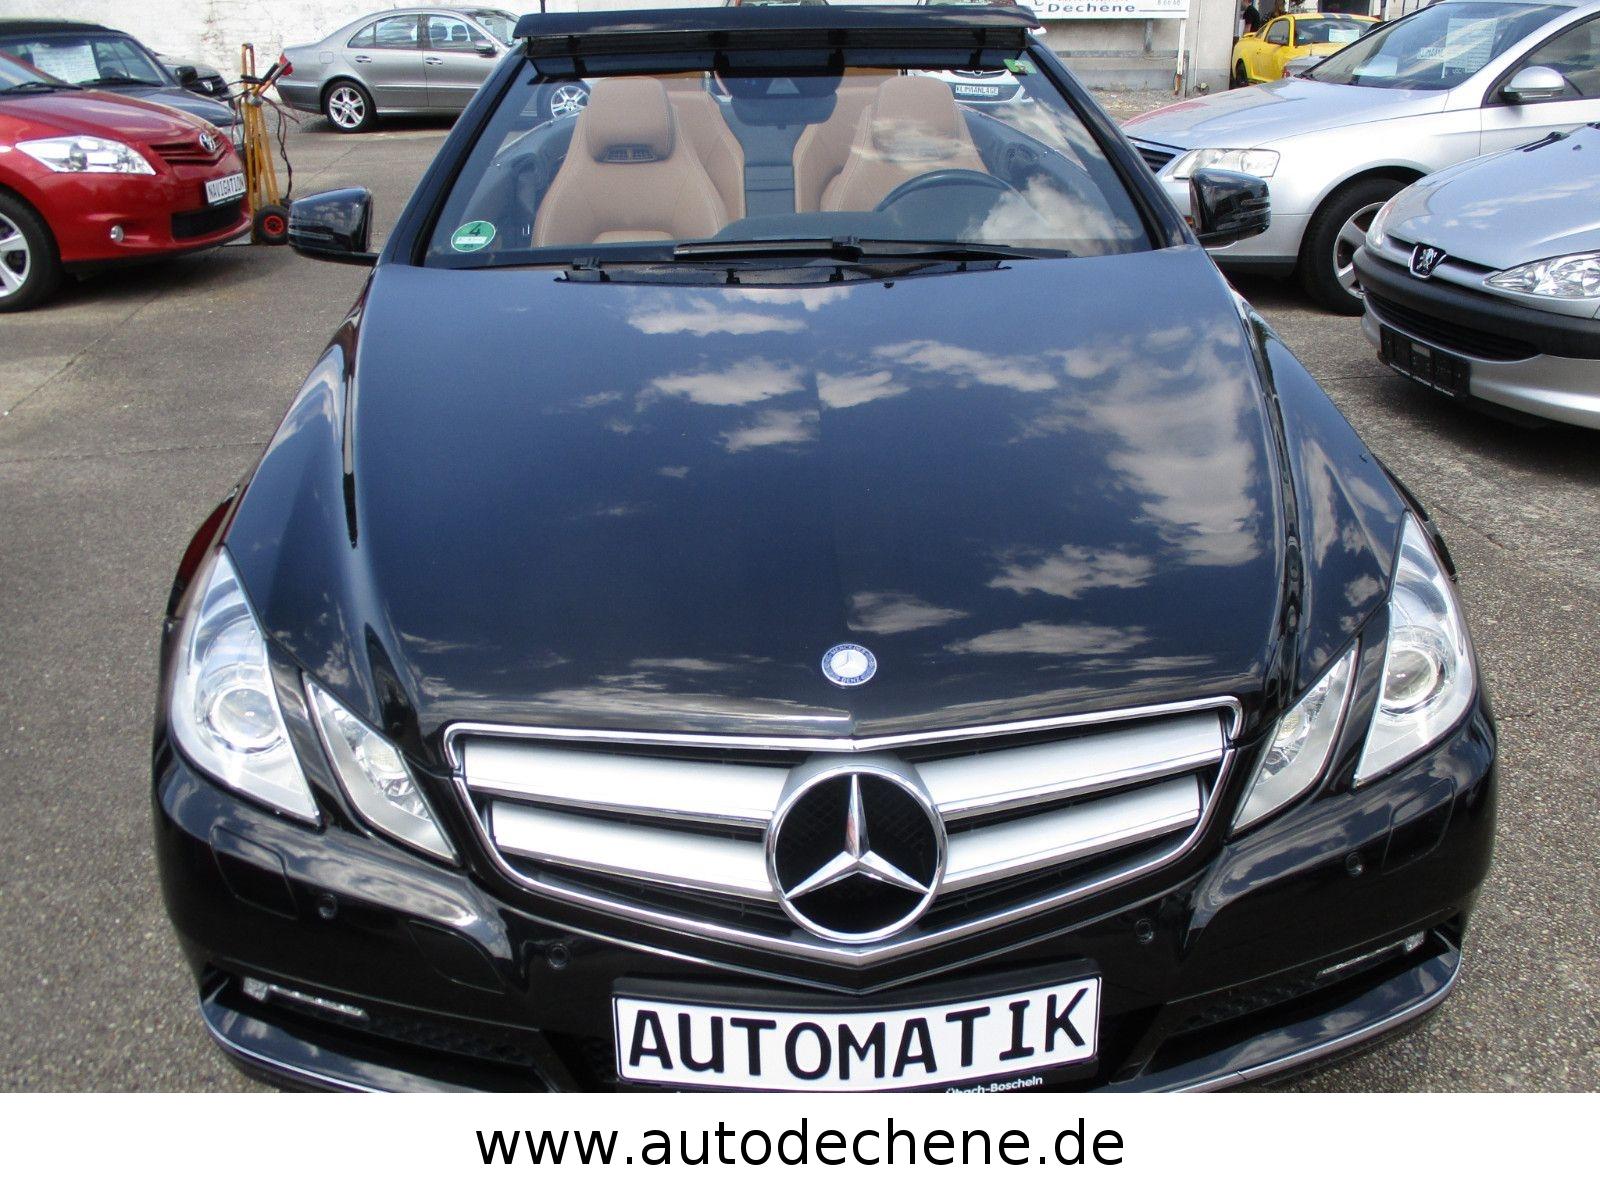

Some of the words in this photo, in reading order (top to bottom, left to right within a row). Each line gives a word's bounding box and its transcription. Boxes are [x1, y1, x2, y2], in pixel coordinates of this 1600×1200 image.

[1047, 3, 1136, 13] Dechene
[208, 176, 245, 198] NAVIGATION
[468, 223, 482, 236] 4
[629, 988, 1088, 1081] AUTOMATIK
